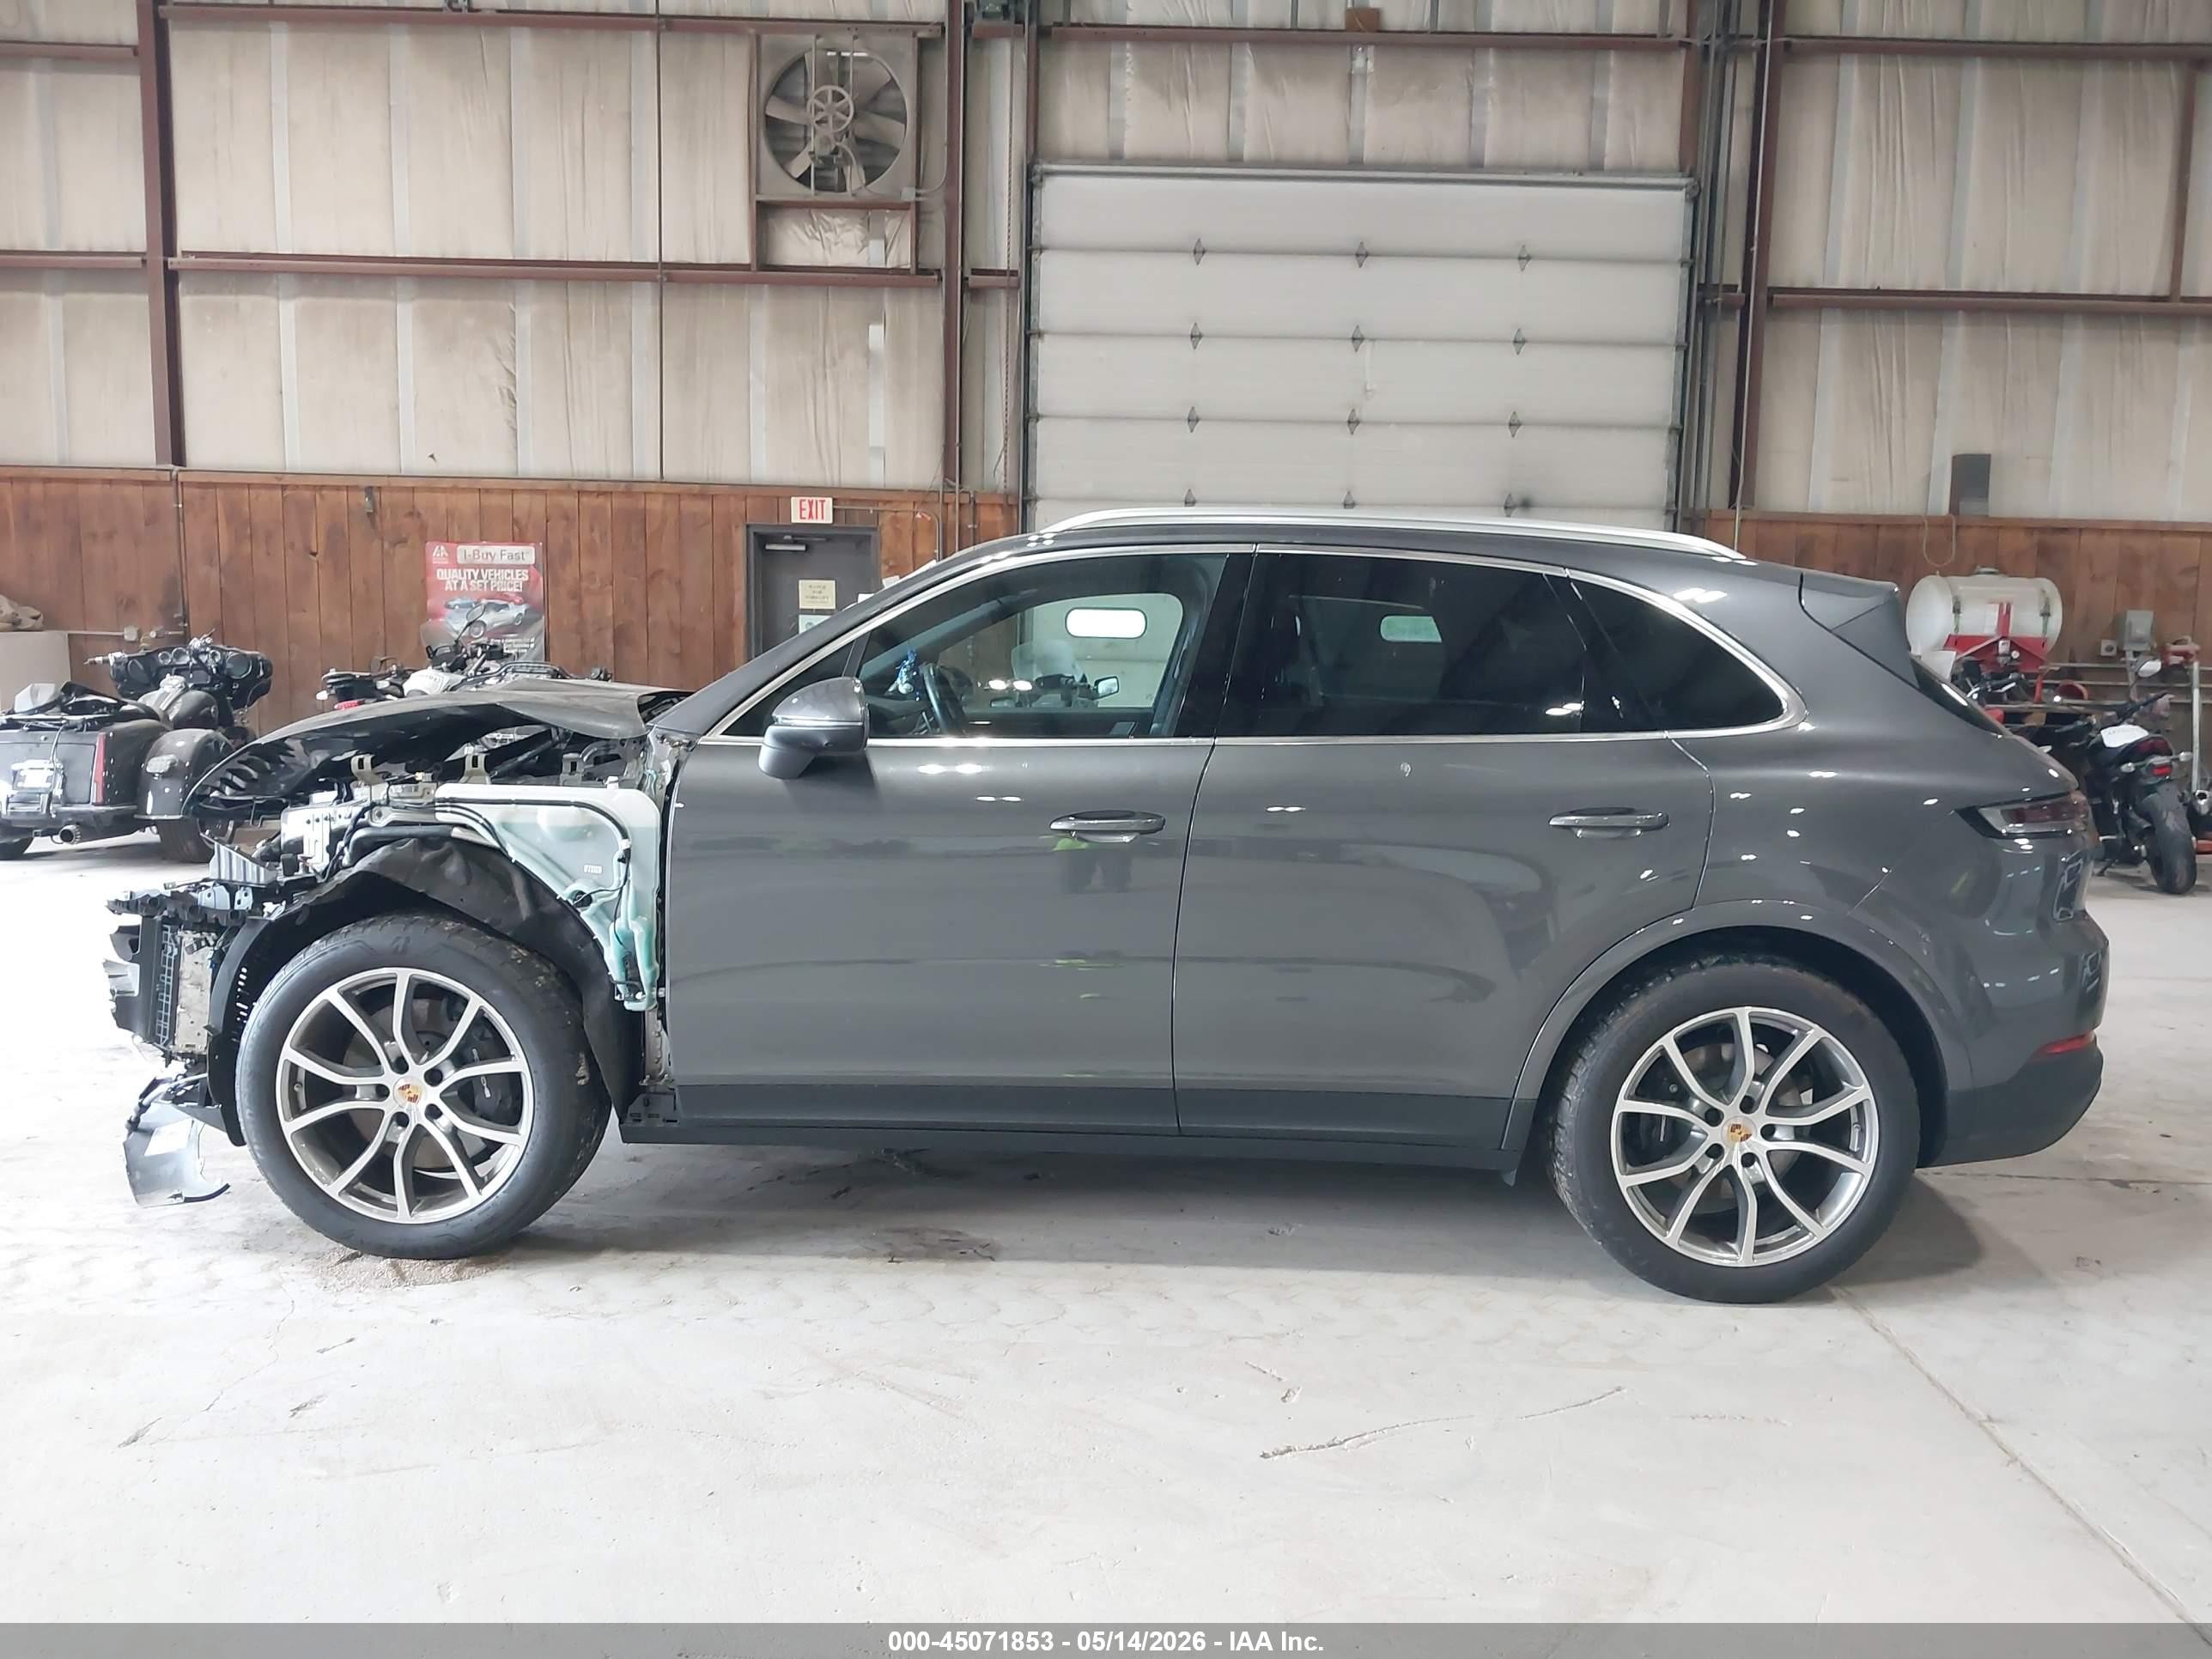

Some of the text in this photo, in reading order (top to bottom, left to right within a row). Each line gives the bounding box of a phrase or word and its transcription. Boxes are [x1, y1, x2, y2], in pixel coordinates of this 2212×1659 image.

[799, 498, 826, 520] EXIT
[464, 549, 526, 562] I-Buy Fast
[436, 568, 530, 581] QUALITY VEHICLES
[445, 580, 523, 592] AT A SET PRICE!
